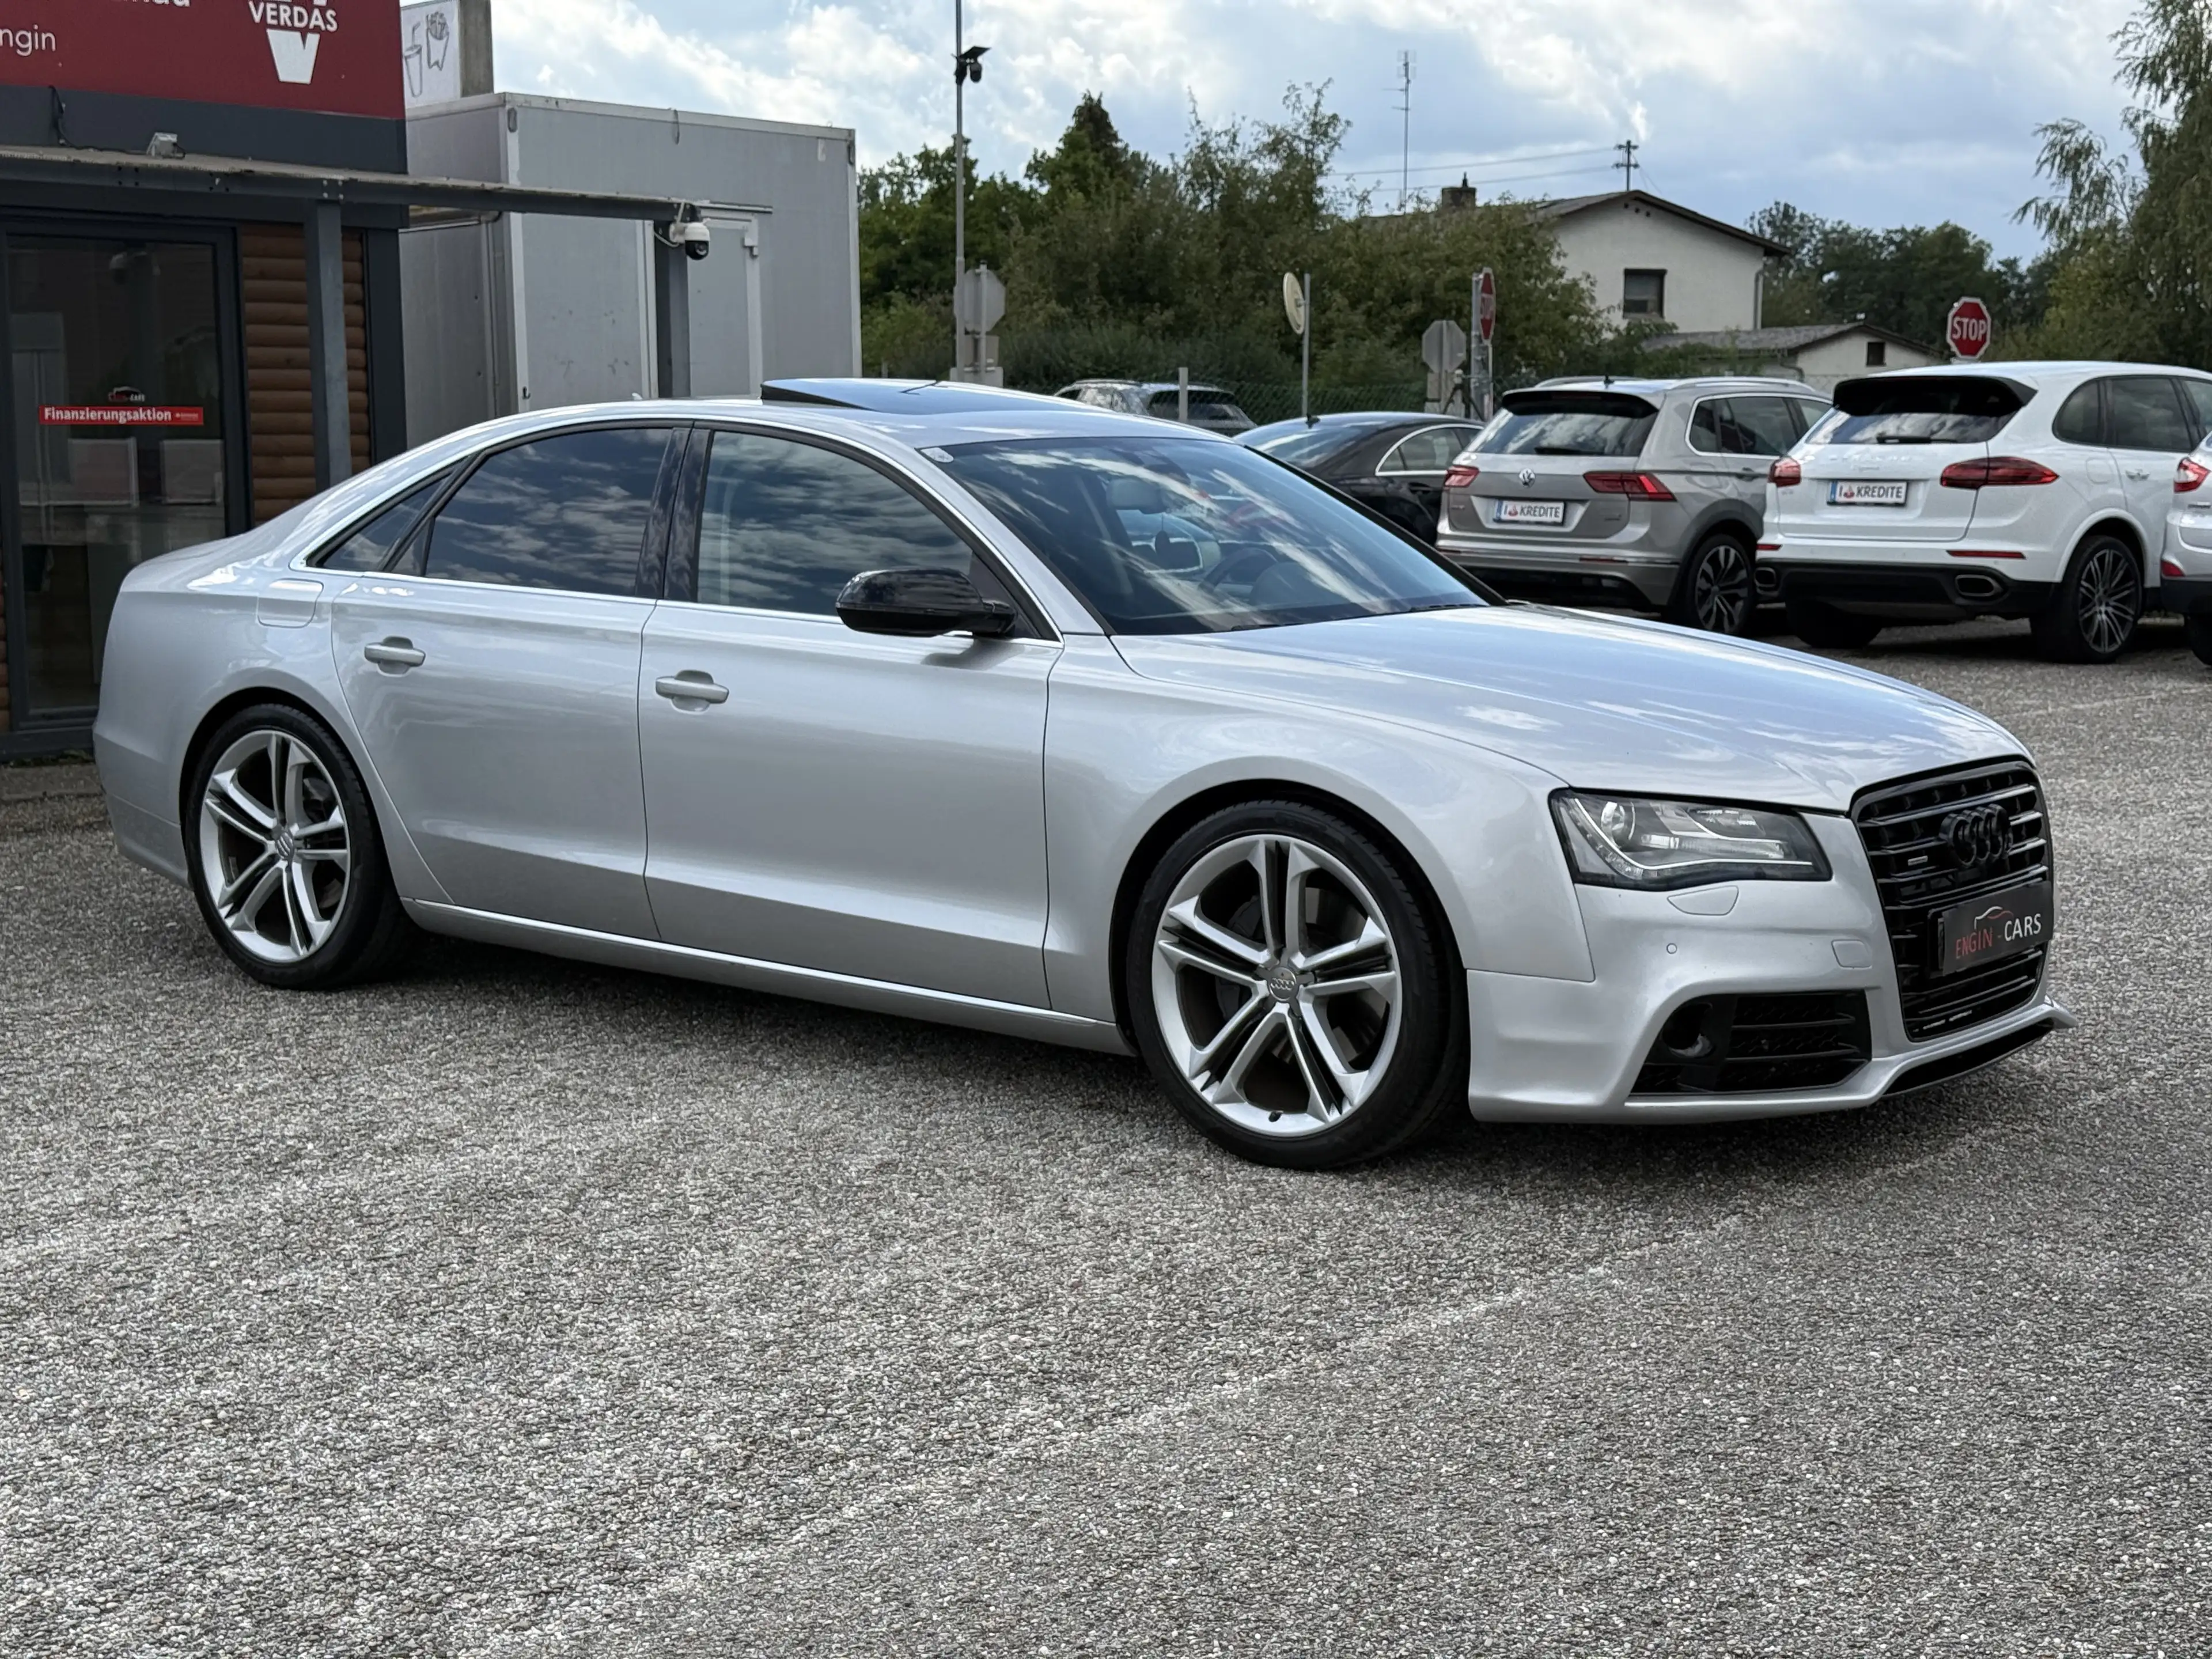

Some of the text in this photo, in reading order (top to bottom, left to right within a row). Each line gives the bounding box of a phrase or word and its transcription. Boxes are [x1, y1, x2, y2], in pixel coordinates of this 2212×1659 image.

[248, 1, 338, 32] VERDAS
[0, 24, 56, 56] ngin
[1952, 316, 1987, 341] STOP
[44, 407, 172, 424] Finanzierungsaktion
[1856, 486, 1903, 499] KREDITE
[1520, 505, 1561, 518] KREDITE
[1956, 926, 1993, 959] ENGIN
[2005, 913, 2042, 941] CARS
